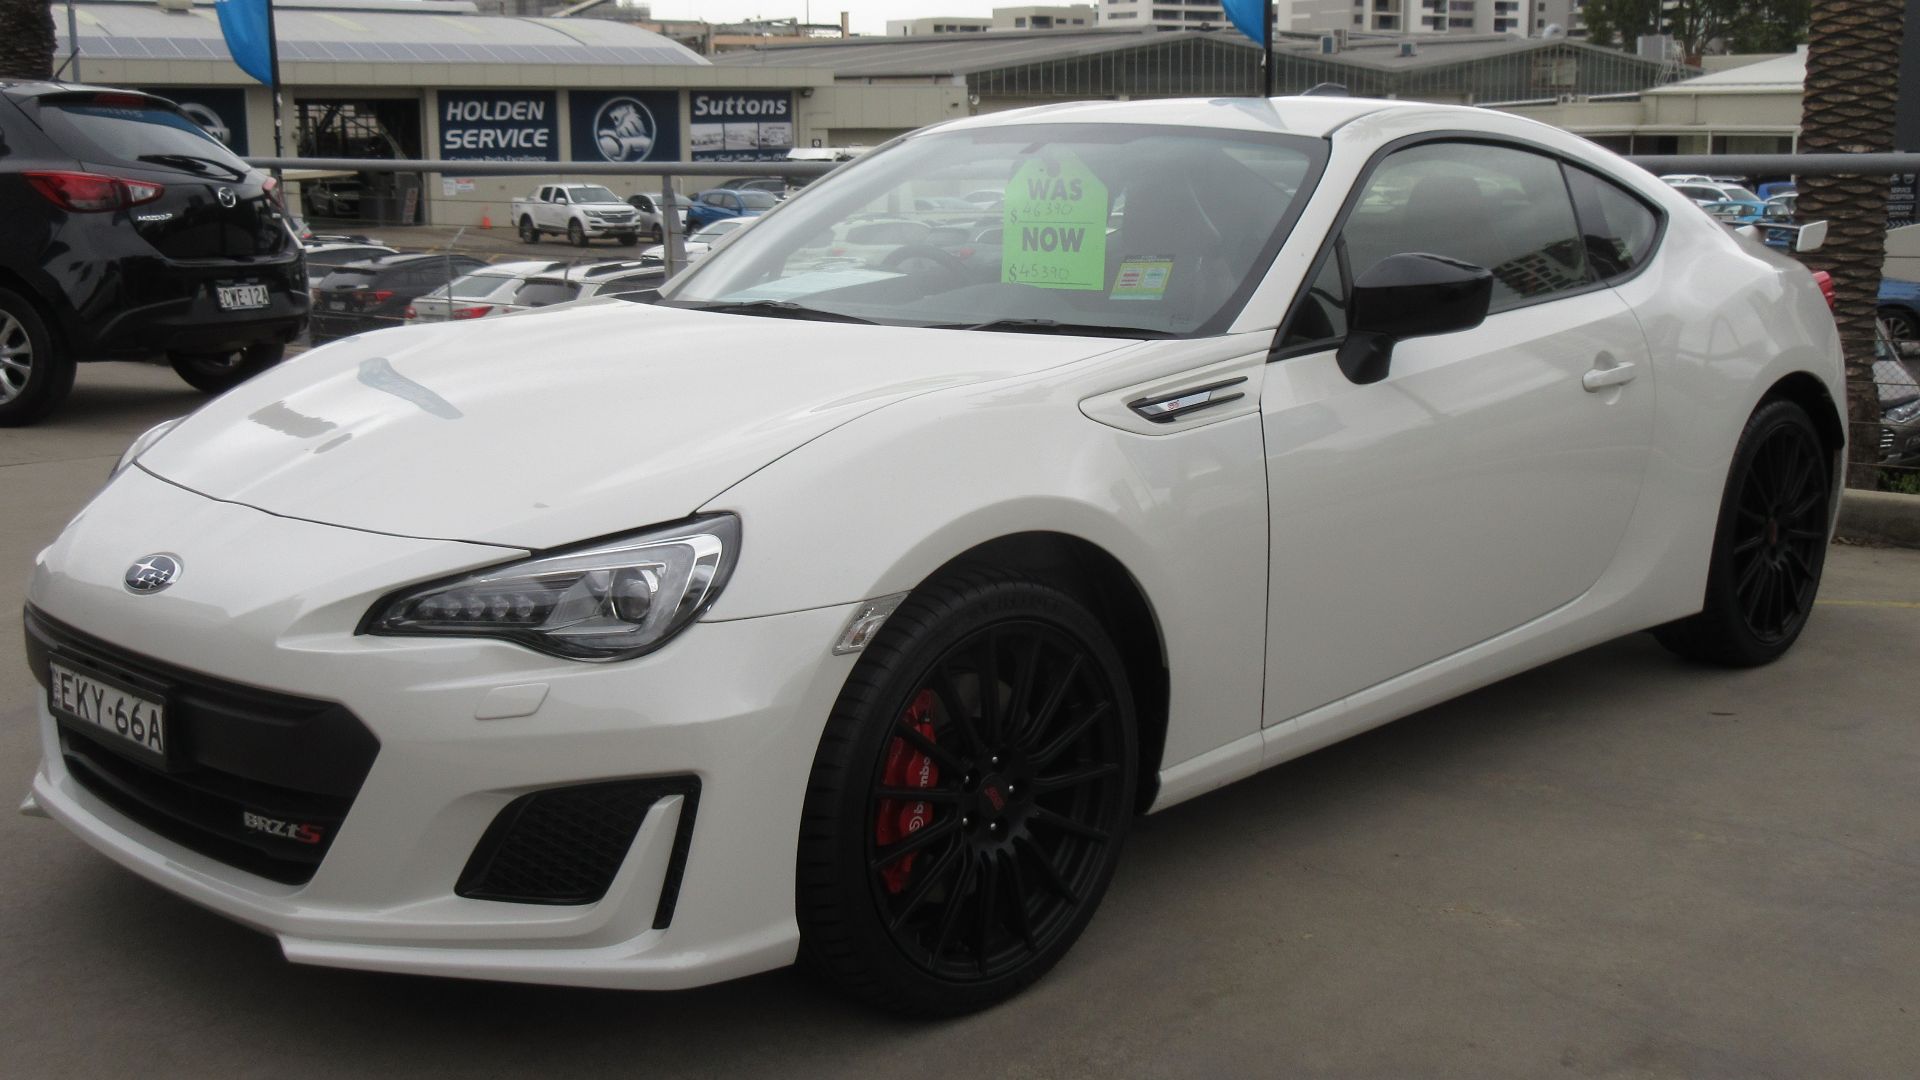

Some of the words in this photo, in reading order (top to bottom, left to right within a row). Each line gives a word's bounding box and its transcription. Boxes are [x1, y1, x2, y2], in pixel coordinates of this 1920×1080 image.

[446, 101, 545, 121] HOLDEN
[694, 96, 787, 116] Suttons
[444, 128, 549, 149] SERVICE
[1027, 177, 1083, 201] WAS
[1022, 226, 1086, 253] NOW
